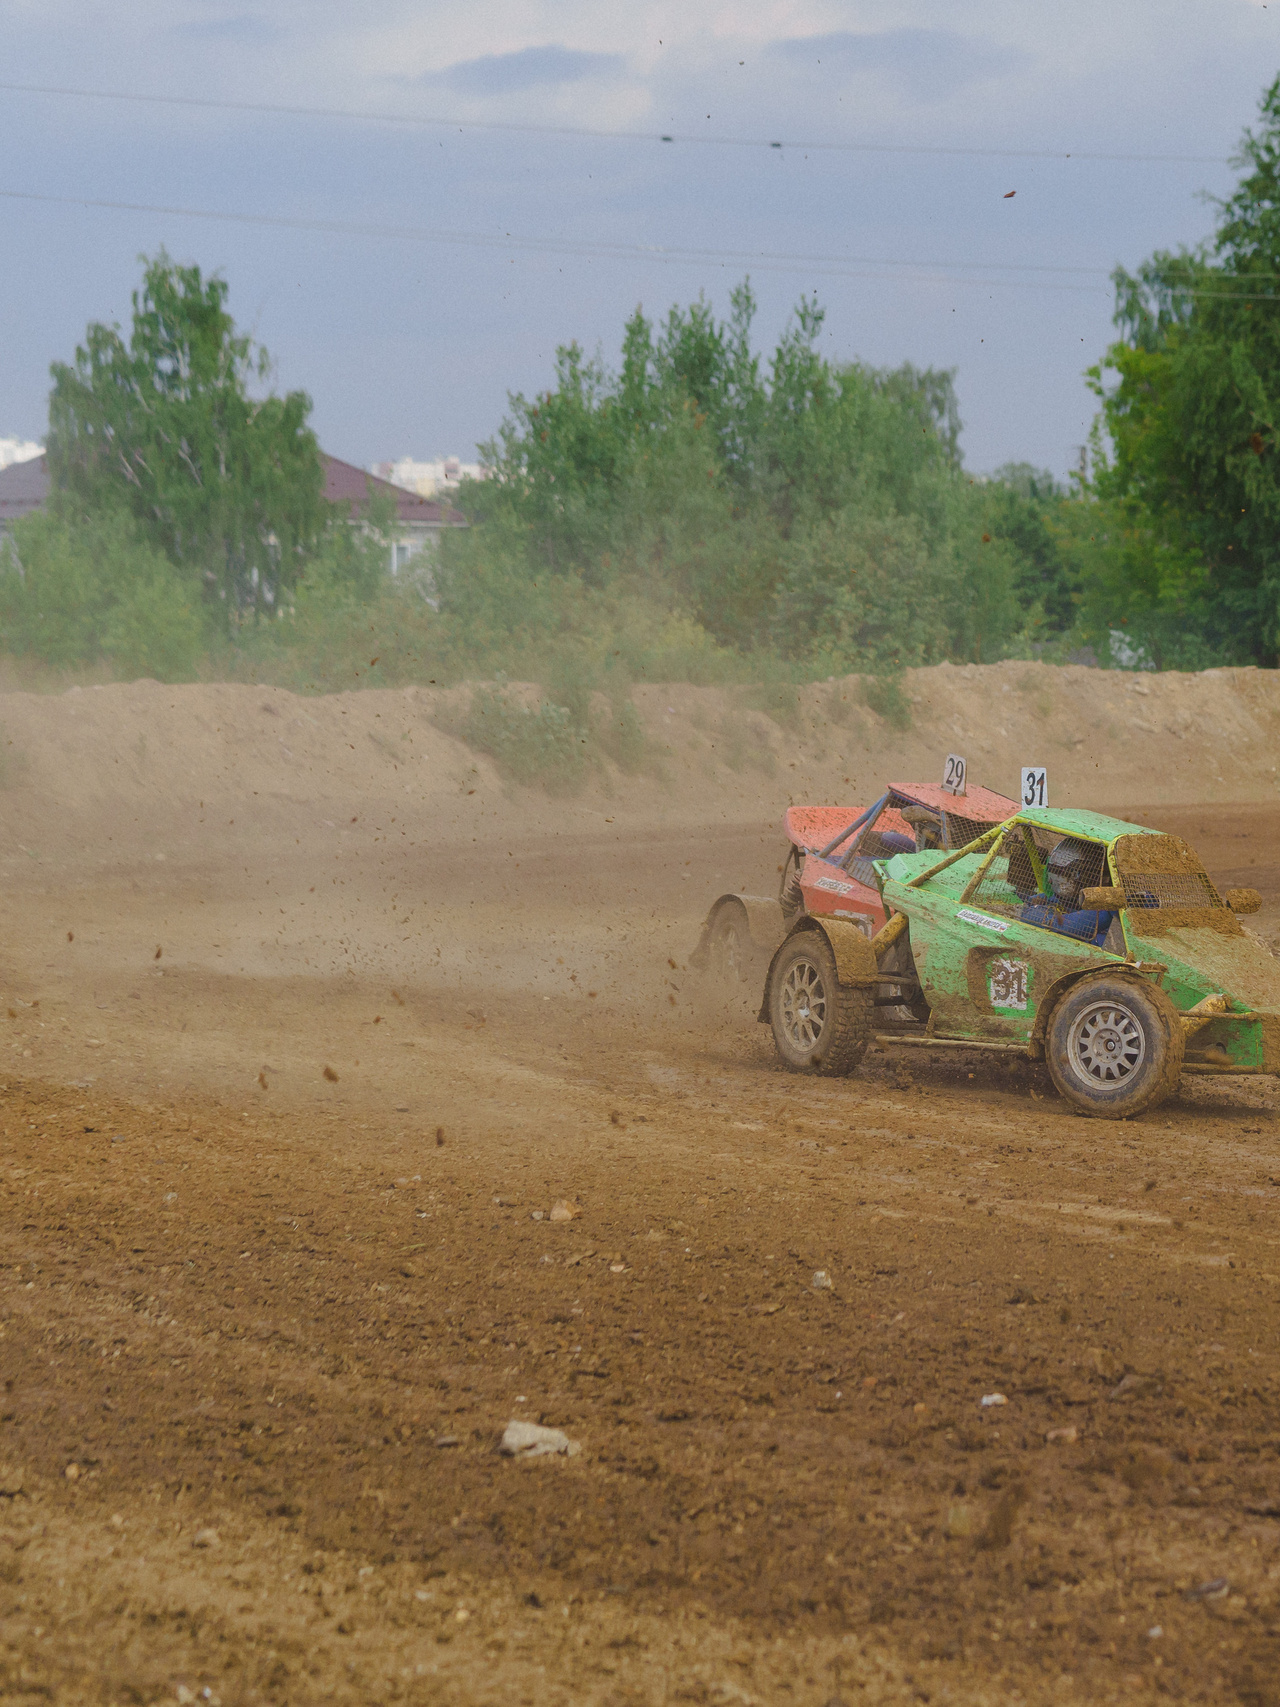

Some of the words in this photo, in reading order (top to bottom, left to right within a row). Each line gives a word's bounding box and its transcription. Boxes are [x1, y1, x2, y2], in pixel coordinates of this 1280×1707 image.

[946, 757, 964, 788] 29
[1024, 772, 1045, 806] 31
[994, 966, 1023, 1003] 31
